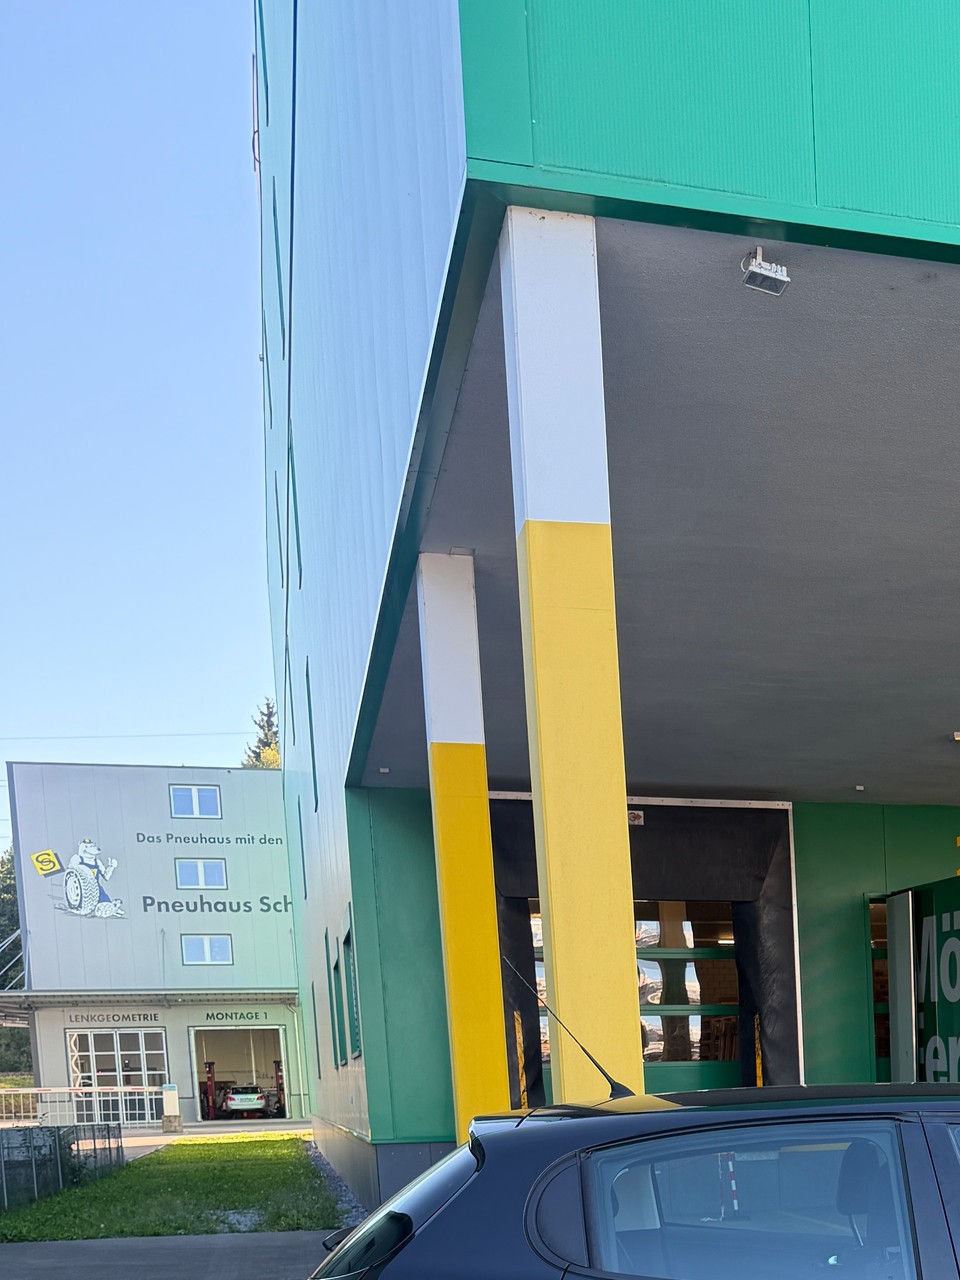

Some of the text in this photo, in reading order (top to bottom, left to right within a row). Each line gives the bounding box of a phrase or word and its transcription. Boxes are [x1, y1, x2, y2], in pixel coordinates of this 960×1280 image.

[136, 832, 284, 845] Das Pneuhaus mit den
[142, 894, 253, 913] Pneuhaus
[69, 1013, 159, 1023] LENKGEOMETRIE
[205, 1011, 268, 1021] MONTAGE 1
